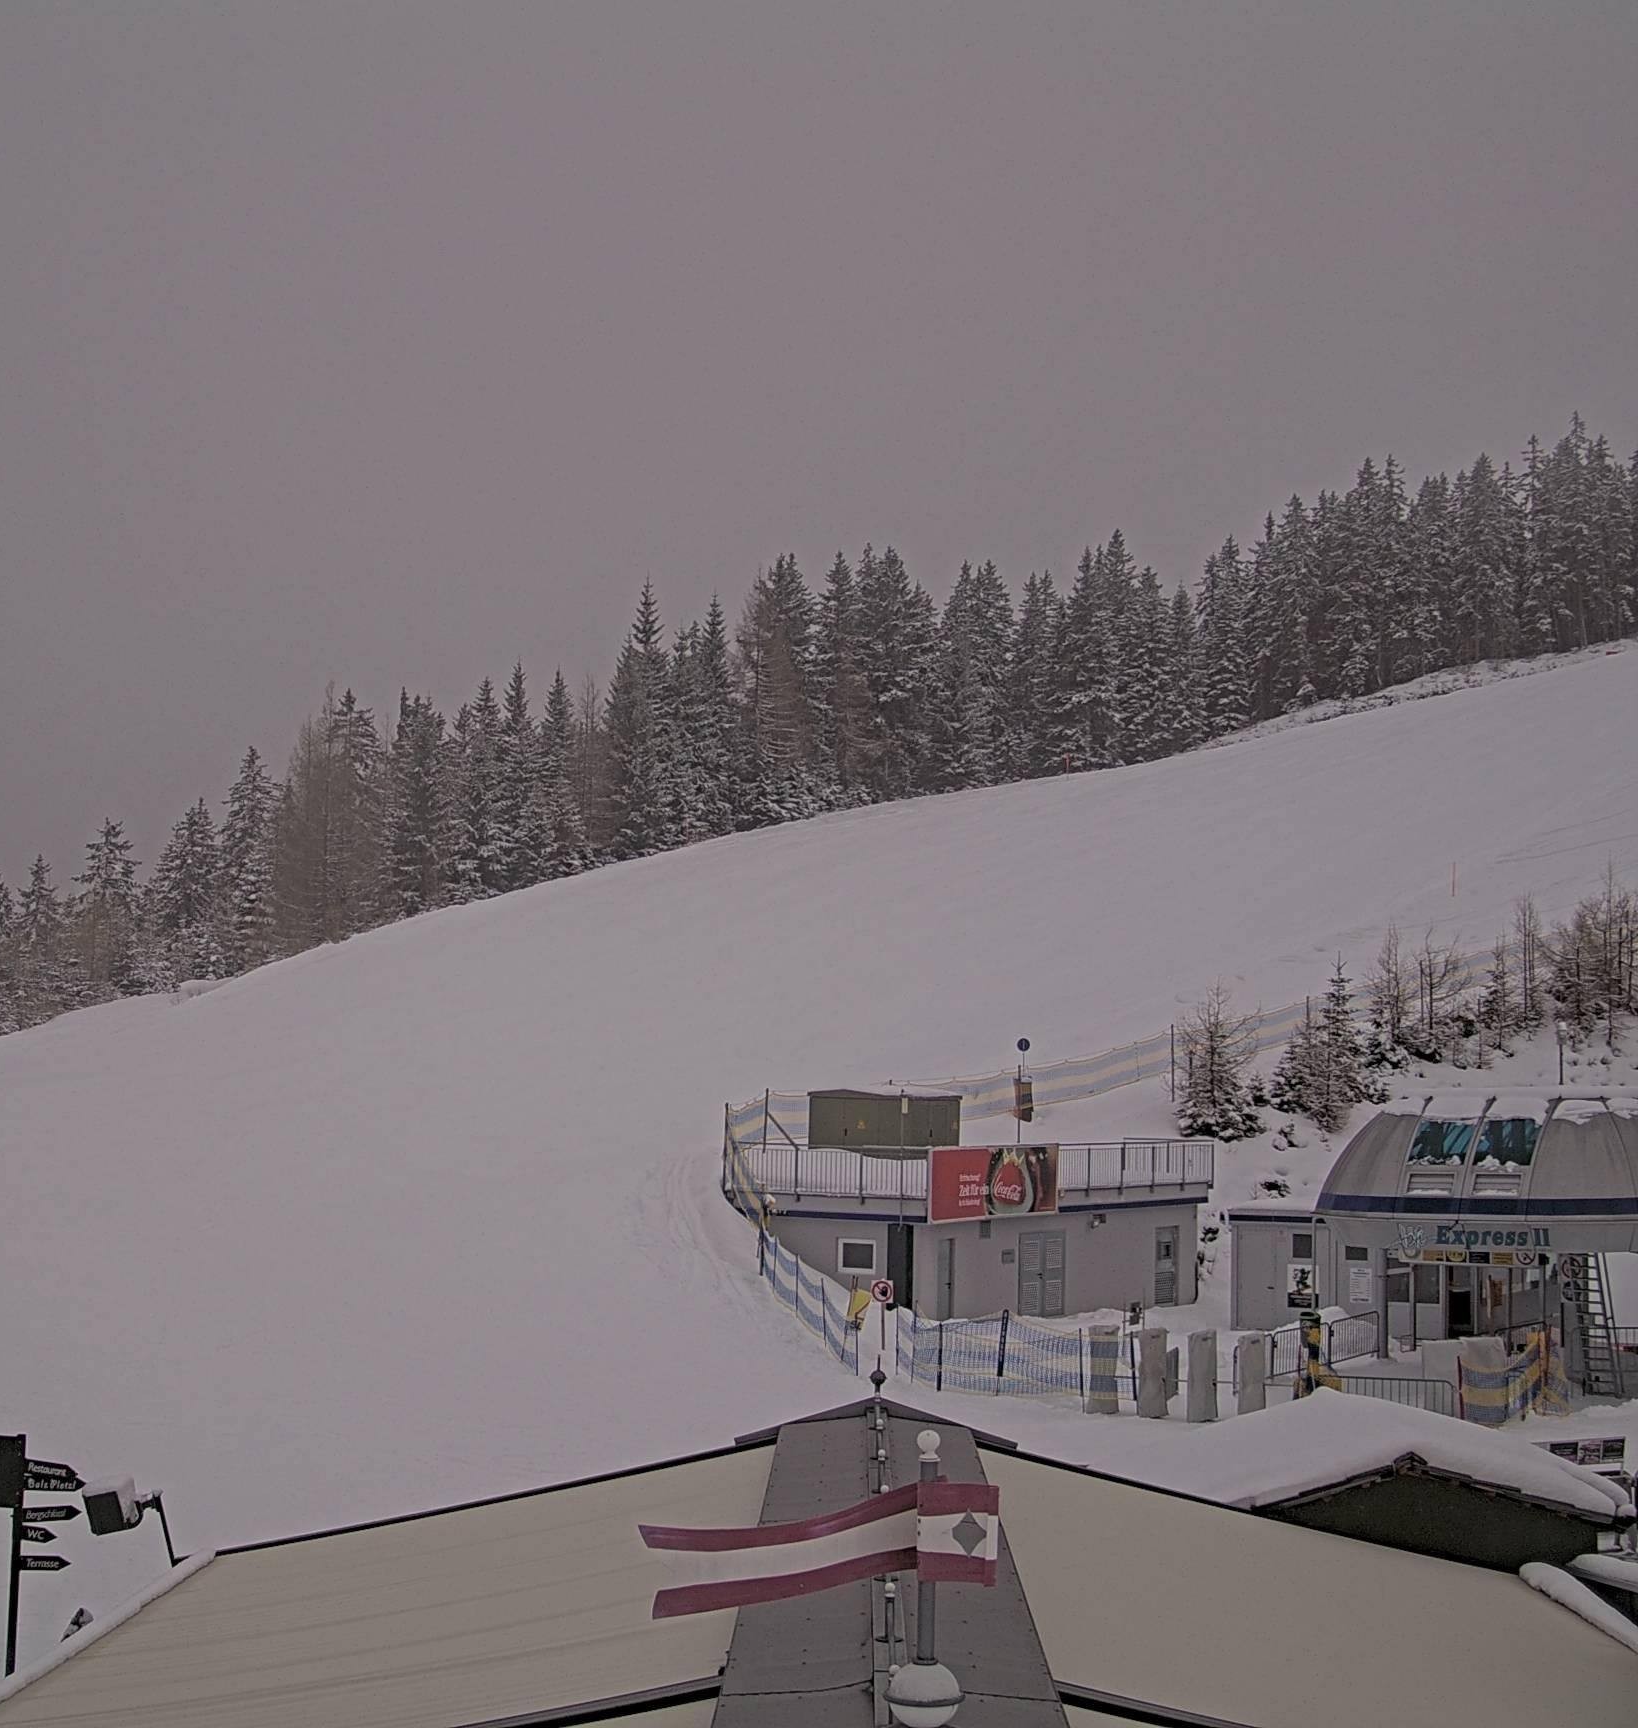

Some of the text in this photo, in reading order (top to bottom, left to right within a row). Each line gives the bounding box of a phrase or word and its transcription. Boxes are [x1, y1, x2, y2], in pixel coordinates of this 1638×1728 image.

[1436, 1225, 1528, 1250] Express
[27, 1461, 67, 1477] Restaurant
[27, 1528, 46, 1540] WC
[26, 1558, 60, 1569] Terrasse
